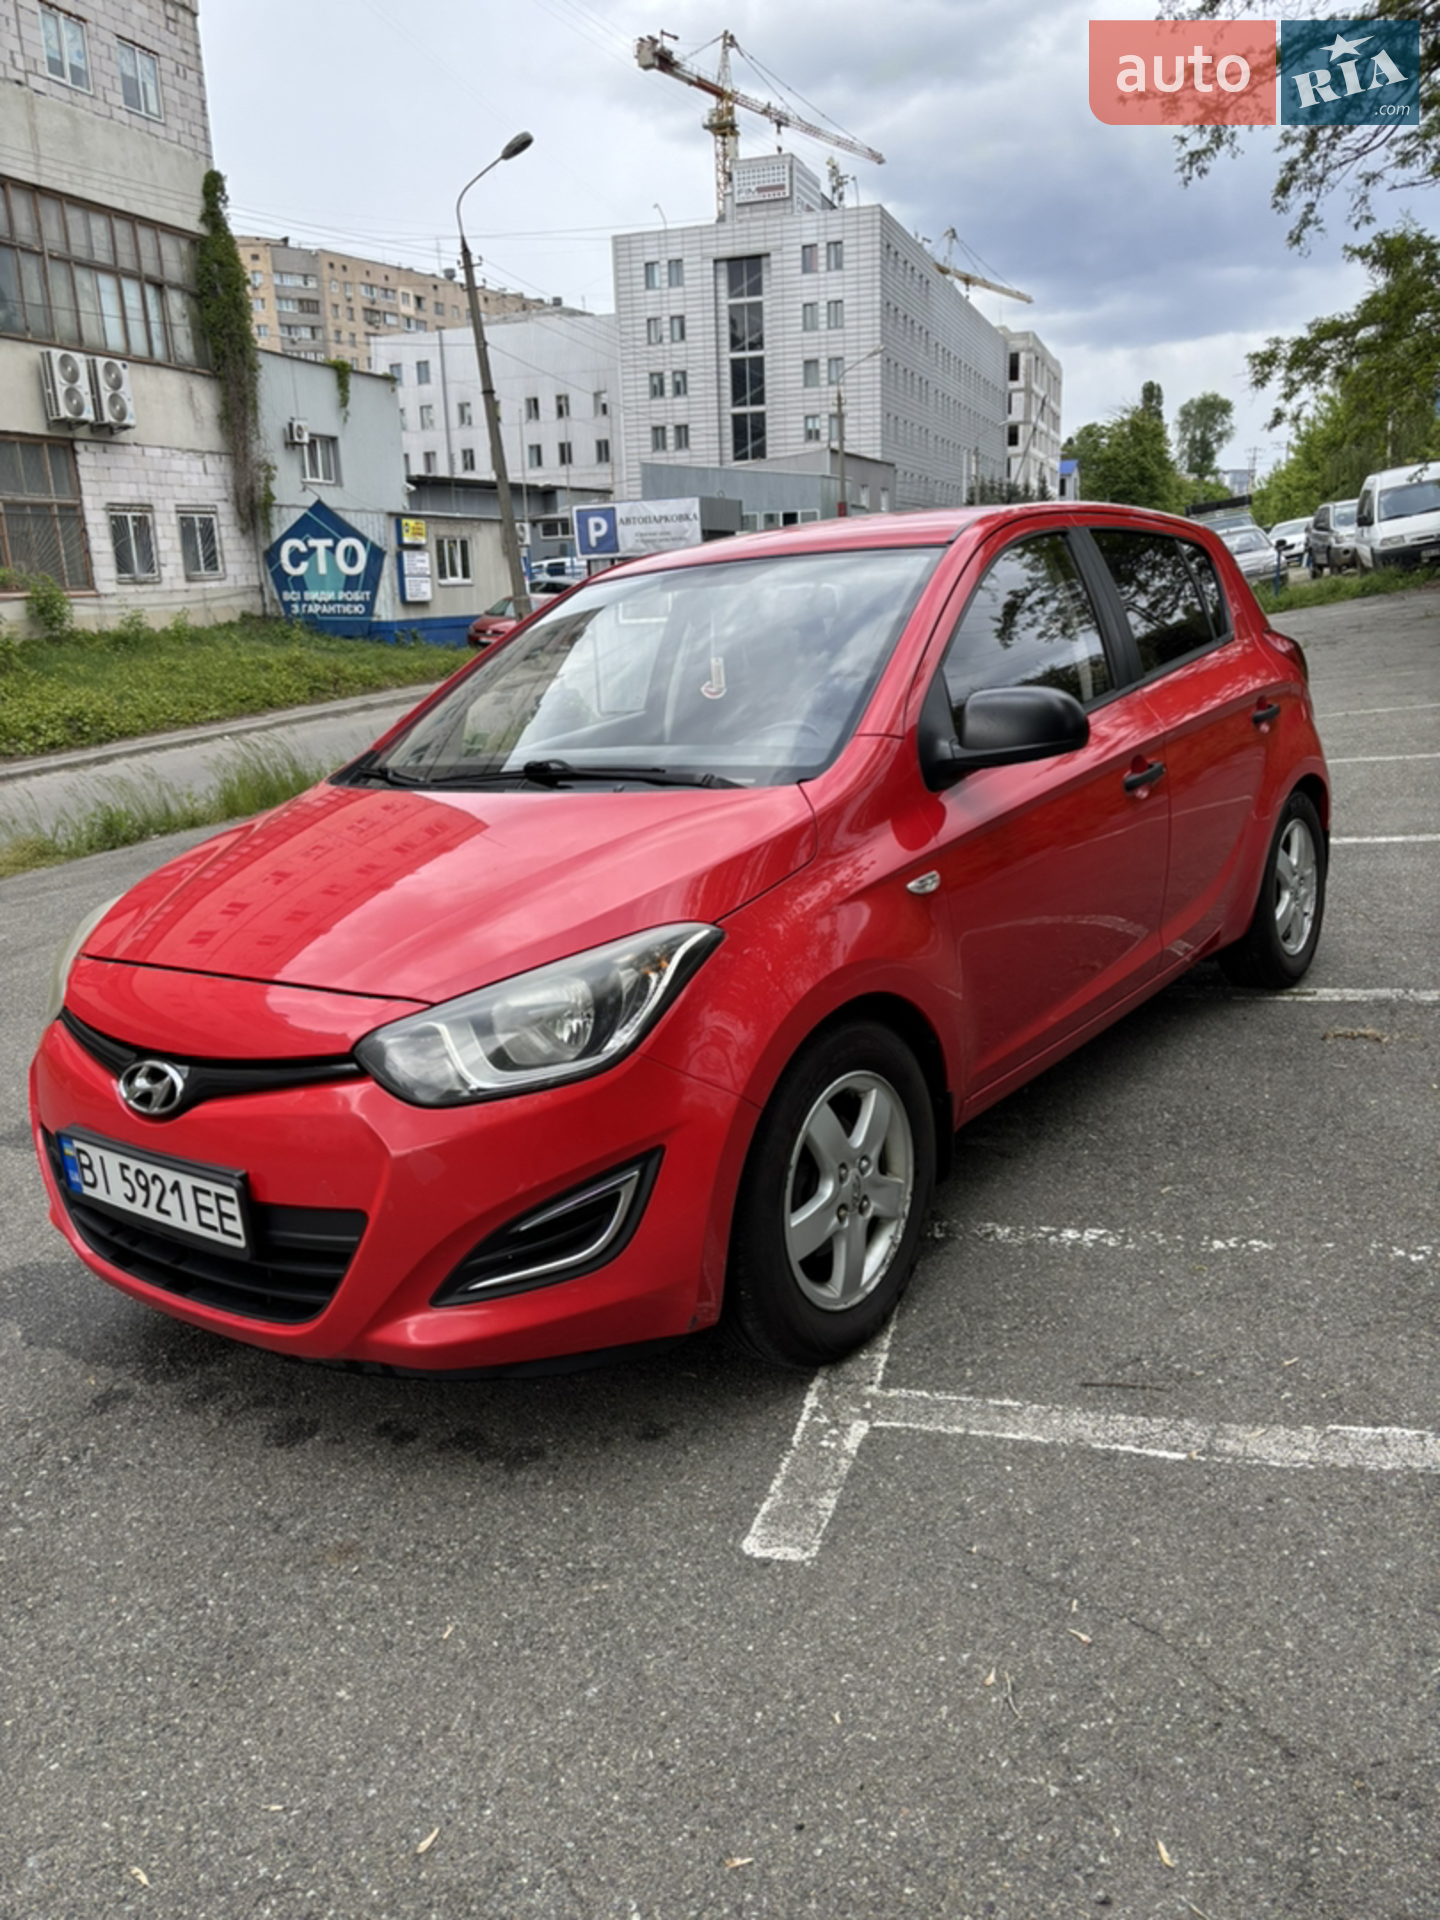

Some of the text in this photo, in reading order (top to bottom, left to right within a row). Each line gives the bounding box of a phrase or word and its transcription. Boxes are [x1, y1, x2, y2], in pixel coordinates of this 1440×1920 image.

[618, 512, 699, 527] АВТОПАРКОВКА
[587, 516, 609, 548] P
[280, 537, 367, 576] СТО
[282, 590, 371, 603] ВСІ ВИДИ РОБІТ
[302, 603, 366, 615] ГАРАНТІЄЮ
[75, 1147, 111, 1196] BI
